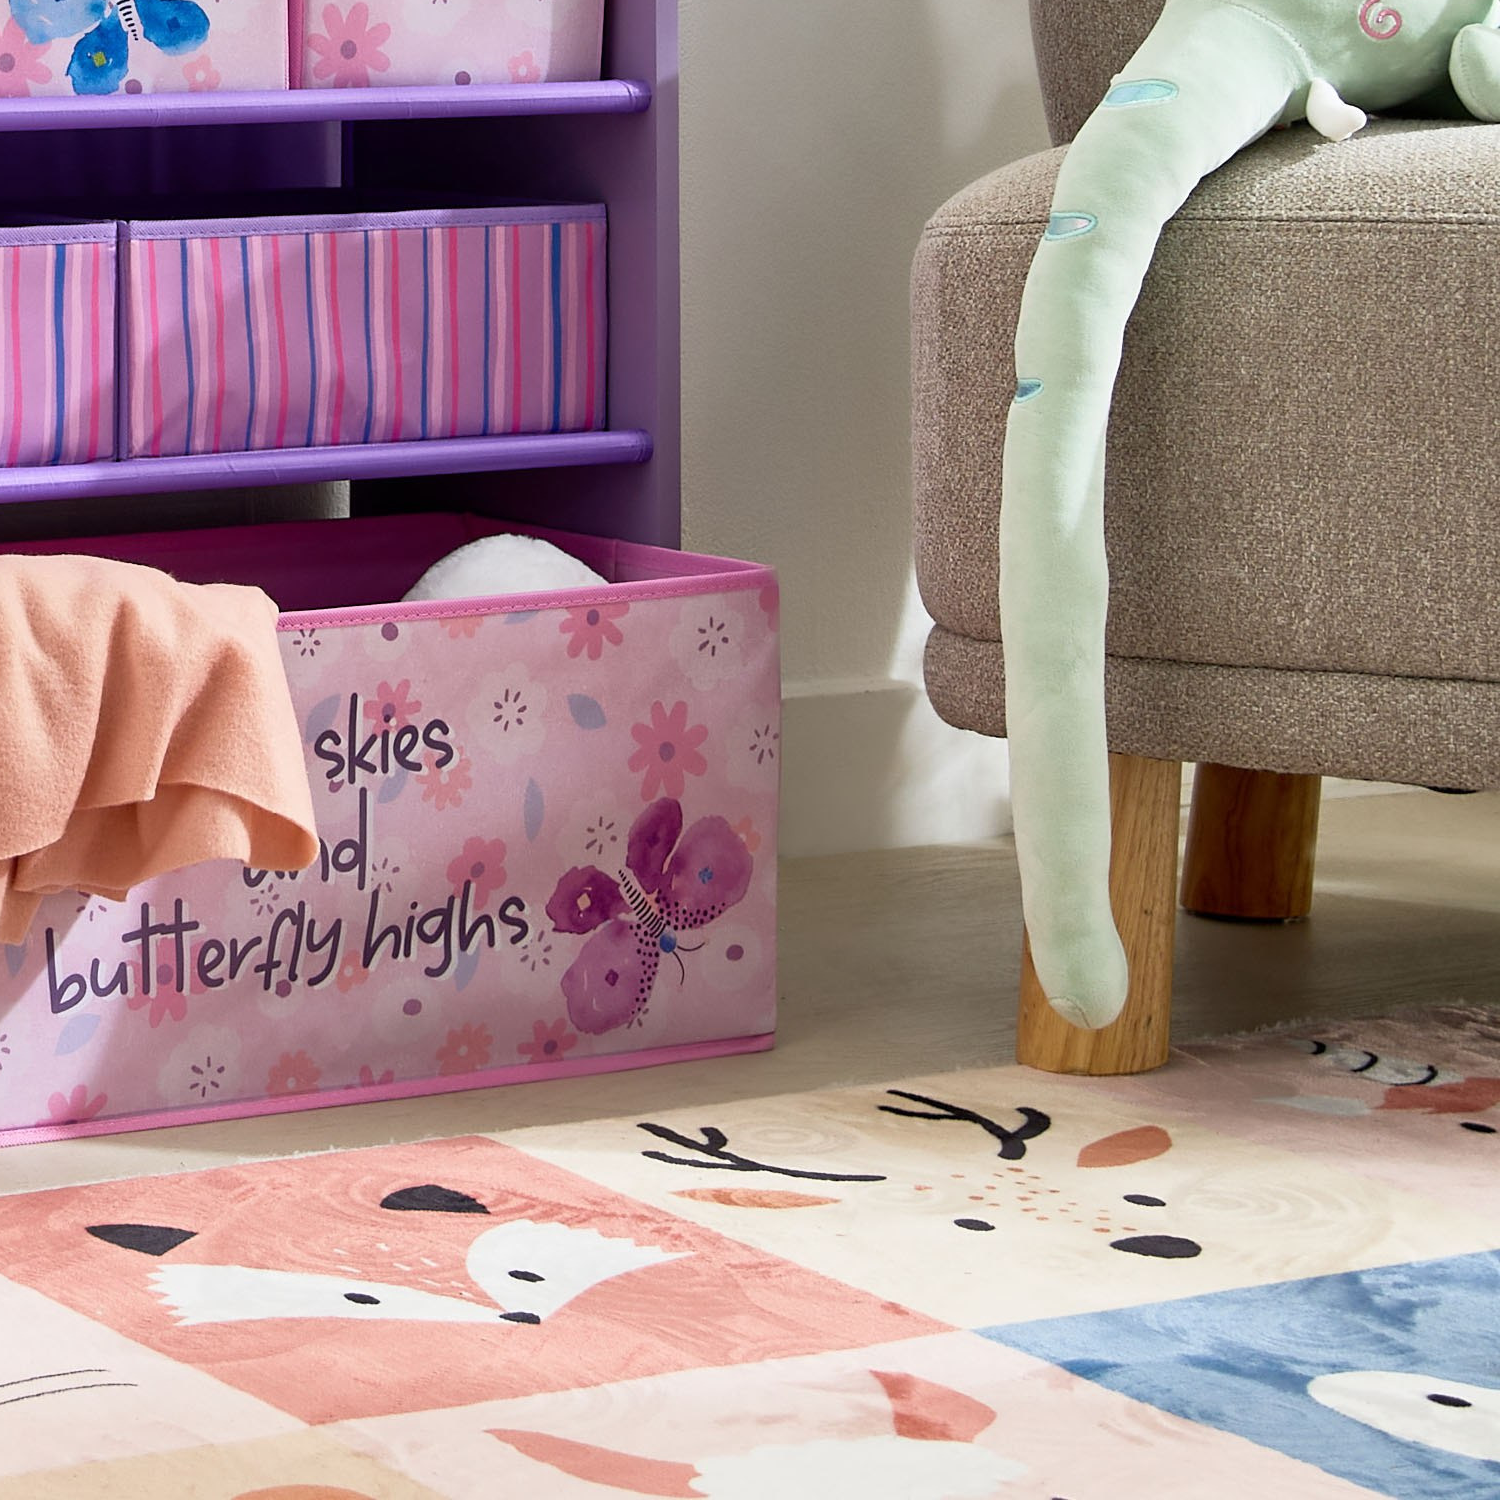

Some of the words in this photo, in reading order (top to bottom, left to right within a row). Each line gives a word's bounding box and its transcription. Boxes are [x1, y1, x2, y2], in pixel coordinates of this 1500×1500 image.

[314, 692, 454, 784] skies
[45, 897, 343, 1014] butterfly
[362, 878, 529, 978] highs
